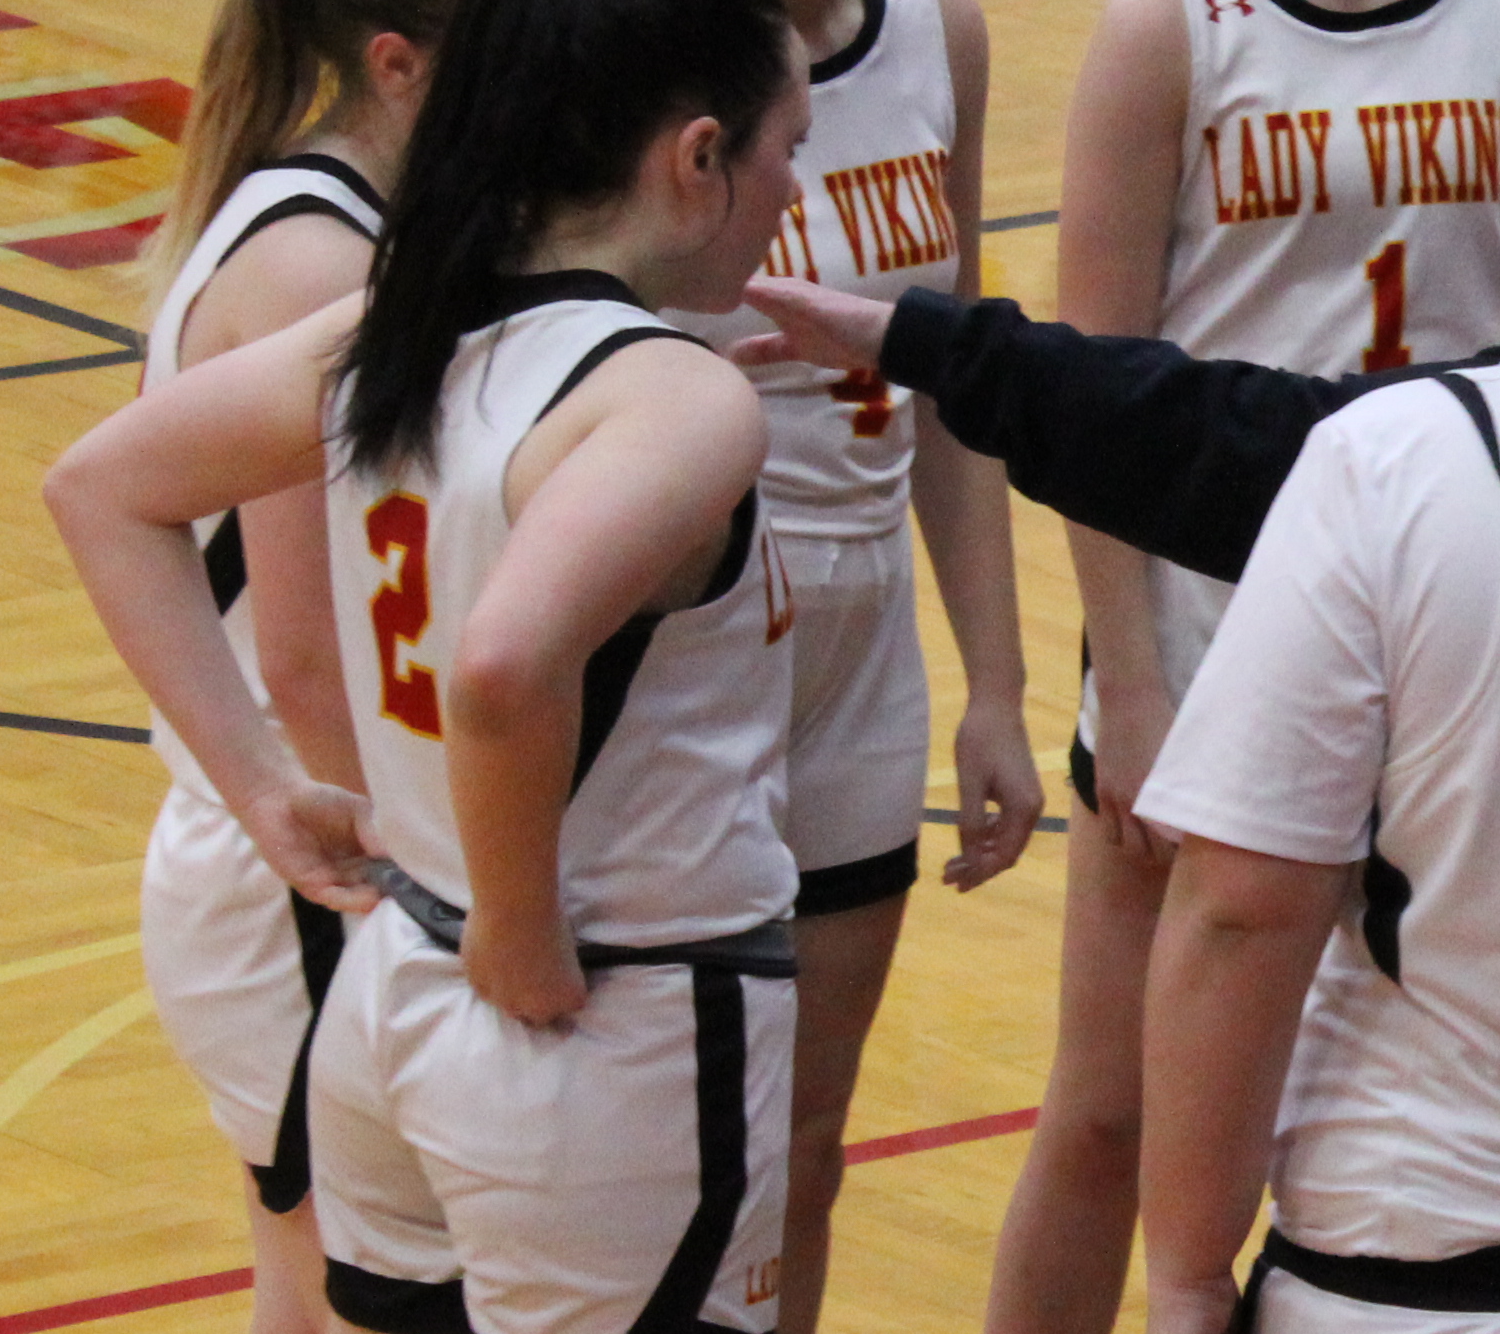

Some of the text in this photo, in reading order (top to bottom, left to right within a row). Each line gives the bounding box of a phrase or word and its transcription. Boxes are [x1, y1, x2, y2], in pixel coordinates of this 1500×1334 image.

[822, 147, 956, 278] VIKIN
[1204, 108, 1333, 225] LADY
[1362, 238, 1413, 374] 1
[364, 490, 445, 743] 2
